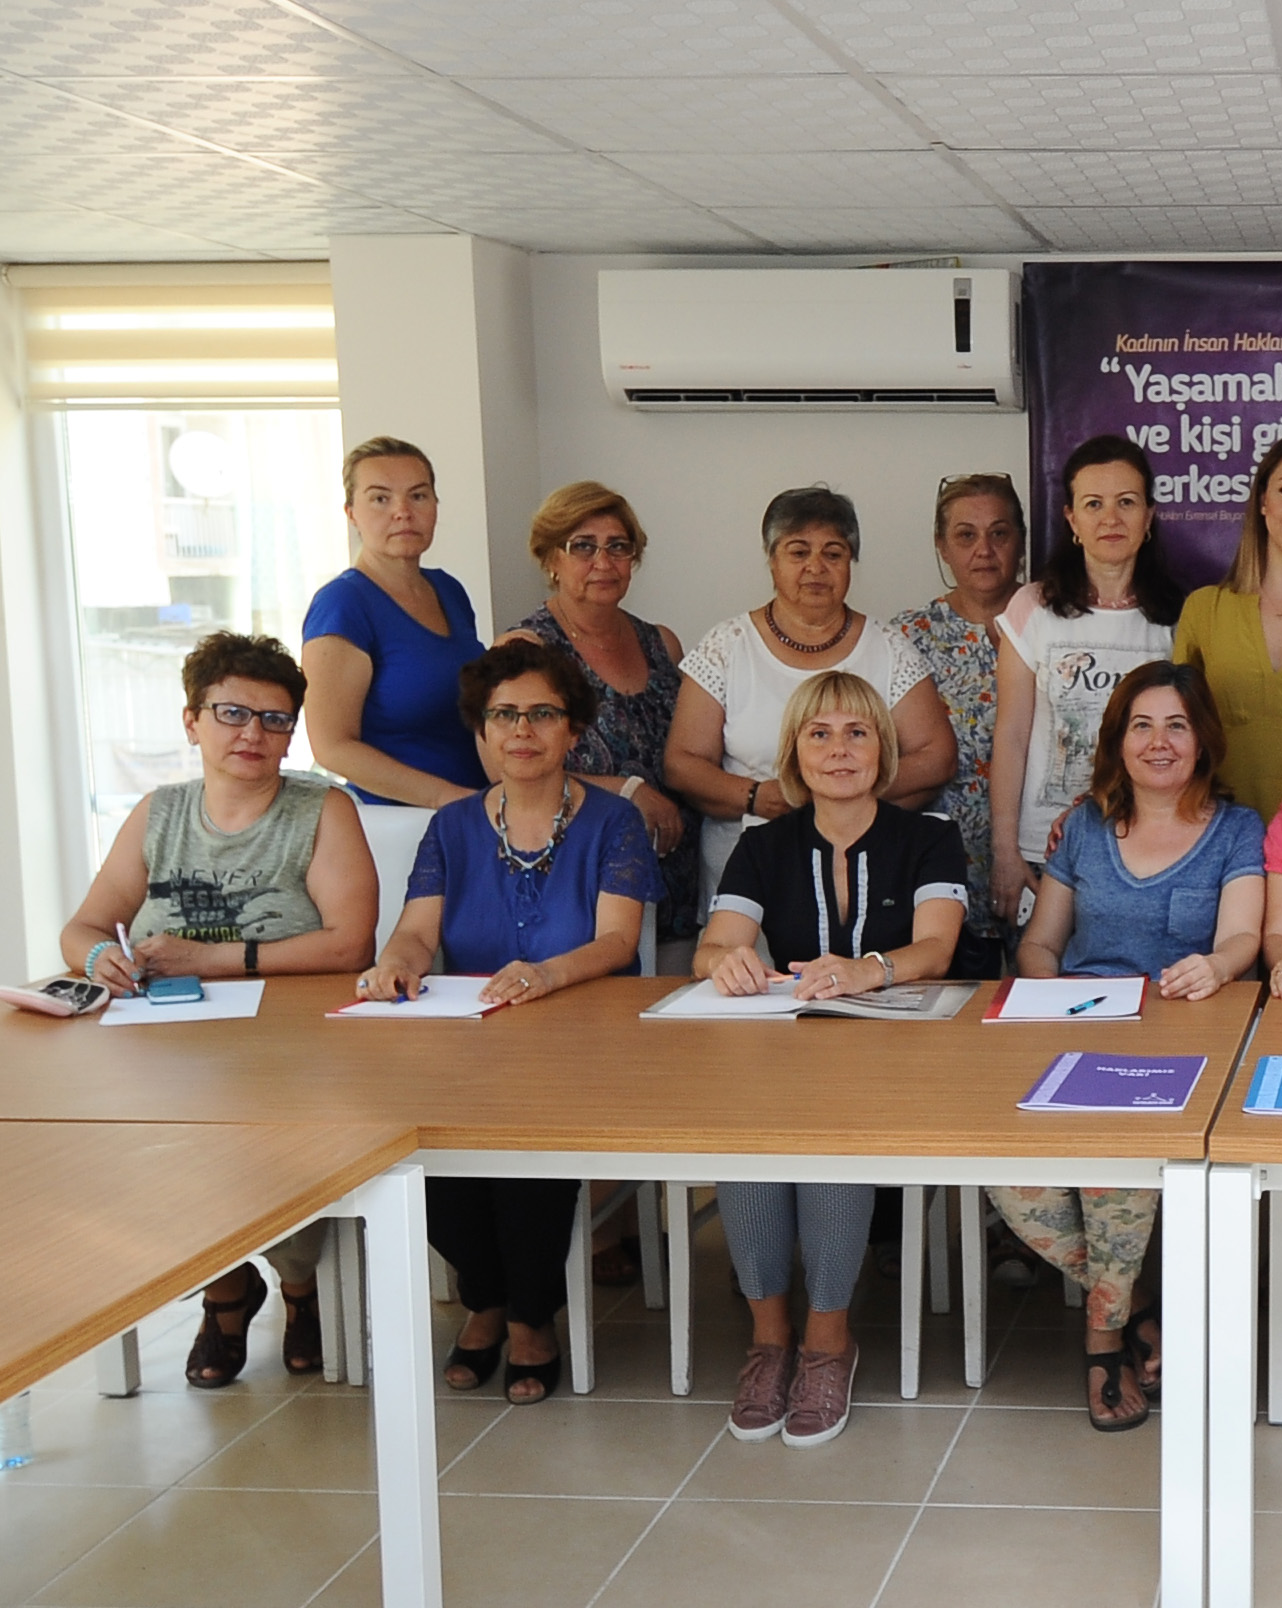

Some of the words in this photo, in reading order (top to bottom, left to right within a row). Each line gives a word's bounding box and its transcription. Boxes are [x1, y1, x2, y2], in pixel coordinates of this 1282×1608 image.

[1115, 332, 1179, 354] Kadının
[1183, 328, 1229, 352] İnsan
[1126, 424, 1171, 453] ve
[1180, 413, 1241, 461] kişi
[169, 867, 264, 888] NEVER
